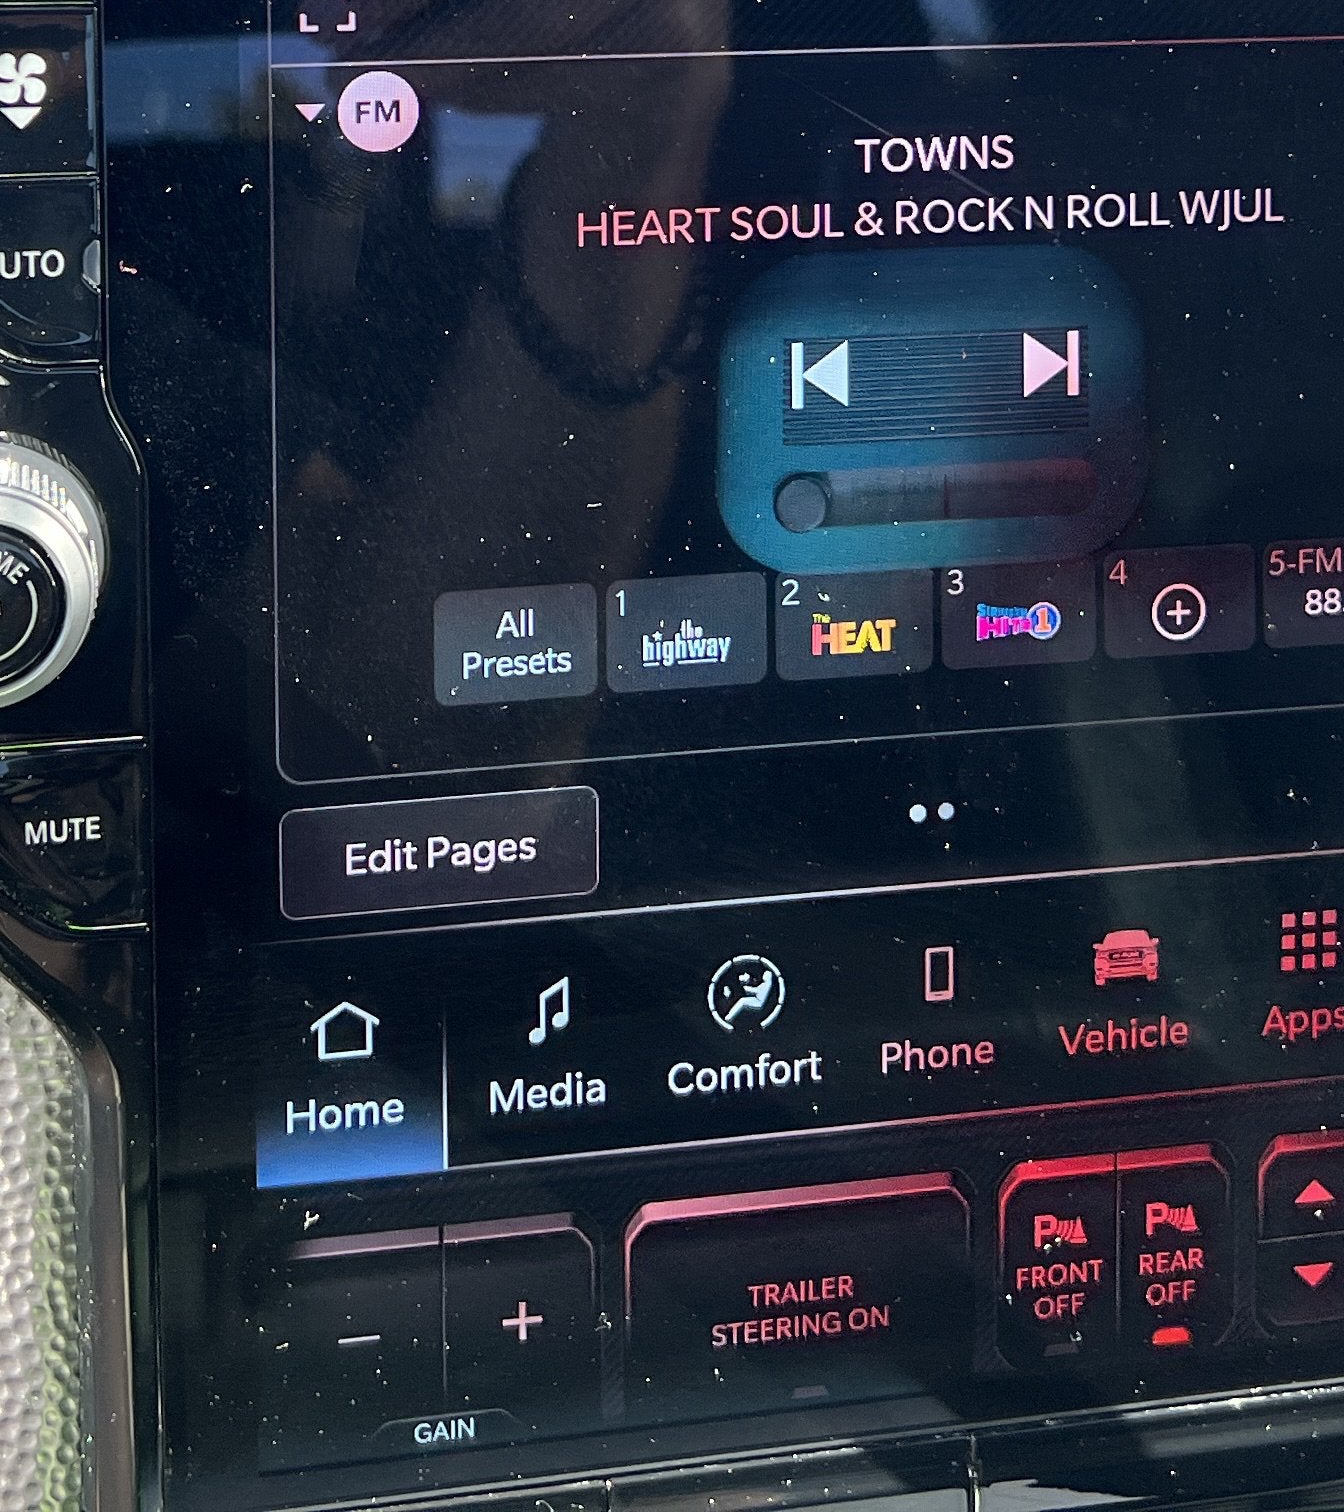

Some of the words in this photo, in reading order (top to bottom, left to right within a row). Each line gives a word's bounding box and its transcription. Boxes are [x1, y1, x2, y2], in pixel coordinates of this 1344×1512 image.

[356, 100, 401, 124] FM
[854, 134, 1015, 173] TOWNS
[577, 206, 720, 248] HEART
[730, 202, 842, 242] SOUL
[853, 201, 884, 236] &
[895, 197, 1014, 235] ROCK
[1024, 194, 1054, 230] N
[1066, 191, 1171, 228] ROLL
[1179, 188, 1285, 231] WJUL
[1108, 559, 1128, 586] 4
[1268, 547, 1343, 577] 5-FM
[781, 579, 800, 606] 2
[946, 569, 964, 595] 3
[615, 589, 626, 617] 1
[496, 608, 535, 639] All
[811, 618, 897, 656] HEAT
[462, 648, 572, 680] Presets
[642, 631, 732, 667] highway
[24, 815, 101, 846] MUTE
[345, 838, 418, 877] Edit
[426, 834, 537, 874] Pages
[1058, 1014, 1190, 1056] Vehicle
[880, 1037, 995, 1074] Phone
[668, 1050, 823, 1097] Comfort
[489, 1071, 607, 1116] Media
[285, 1098, 405, 1136] Home
[1016, 1257, 1104, 1290] FRONT
[1139, 1246, 1204, 1277] REAR
[747, 1274, 855, 1308] TRAILER
[1032, 1292, 1086, 1321] OFF
[1145, 1278, 1197, 1307] OFF
[710, 1310, 843, 1350] STEERING
[848, 1303, 892, 1334] ON
[413, 1416, 477, 1445] GAIN
